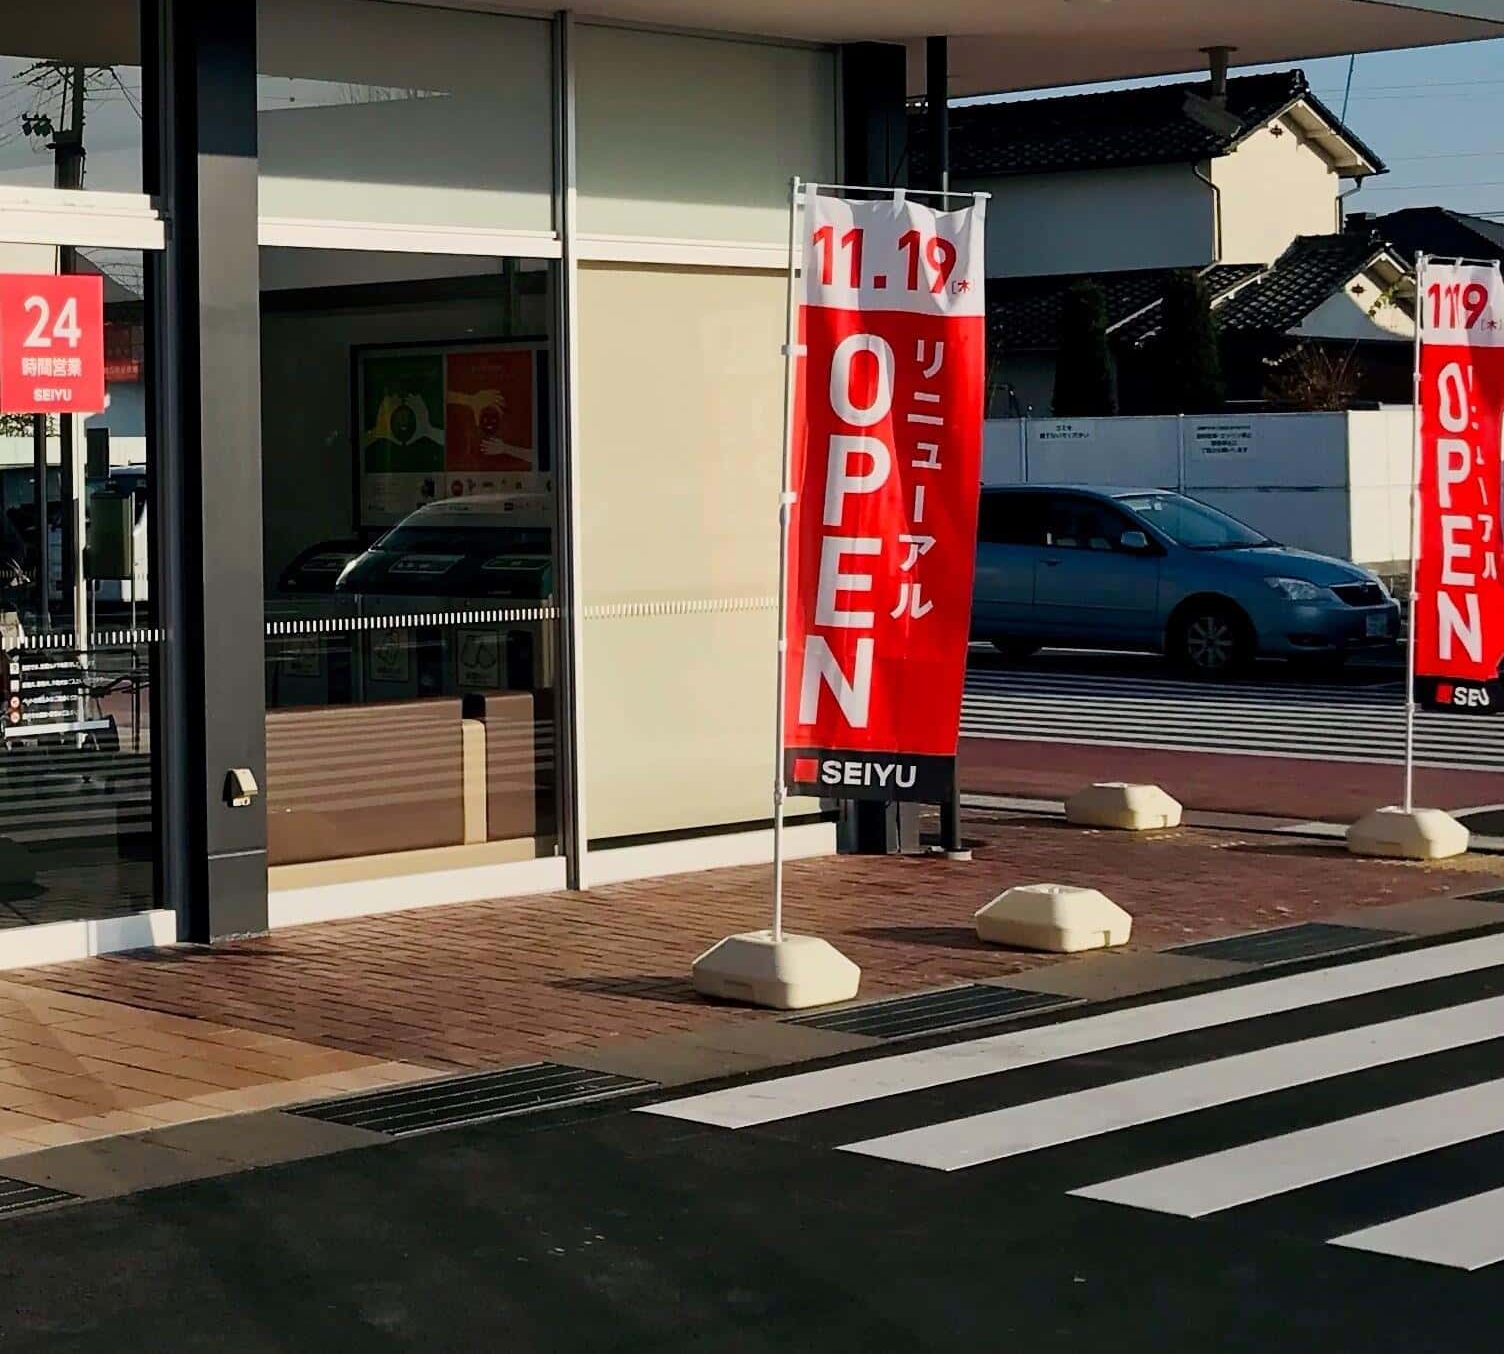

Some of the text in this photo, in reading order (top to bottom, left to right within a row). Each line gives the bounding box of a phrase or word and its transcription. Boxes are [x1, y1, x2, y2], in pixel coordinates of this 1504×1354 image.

[812, 225, 958, 295] 11.19
[23, 295, 83, 349] 24
[21, 357, 83, 377] 時間営業
[32, 388, 73, 402] SEIYU
[890, 338, 944, 620] リニューアル
[798, 333, 896, 730] OPEN
[1437, 362, 1483, 664] OPEN
[820, 759, 918, 789] SEIYU
